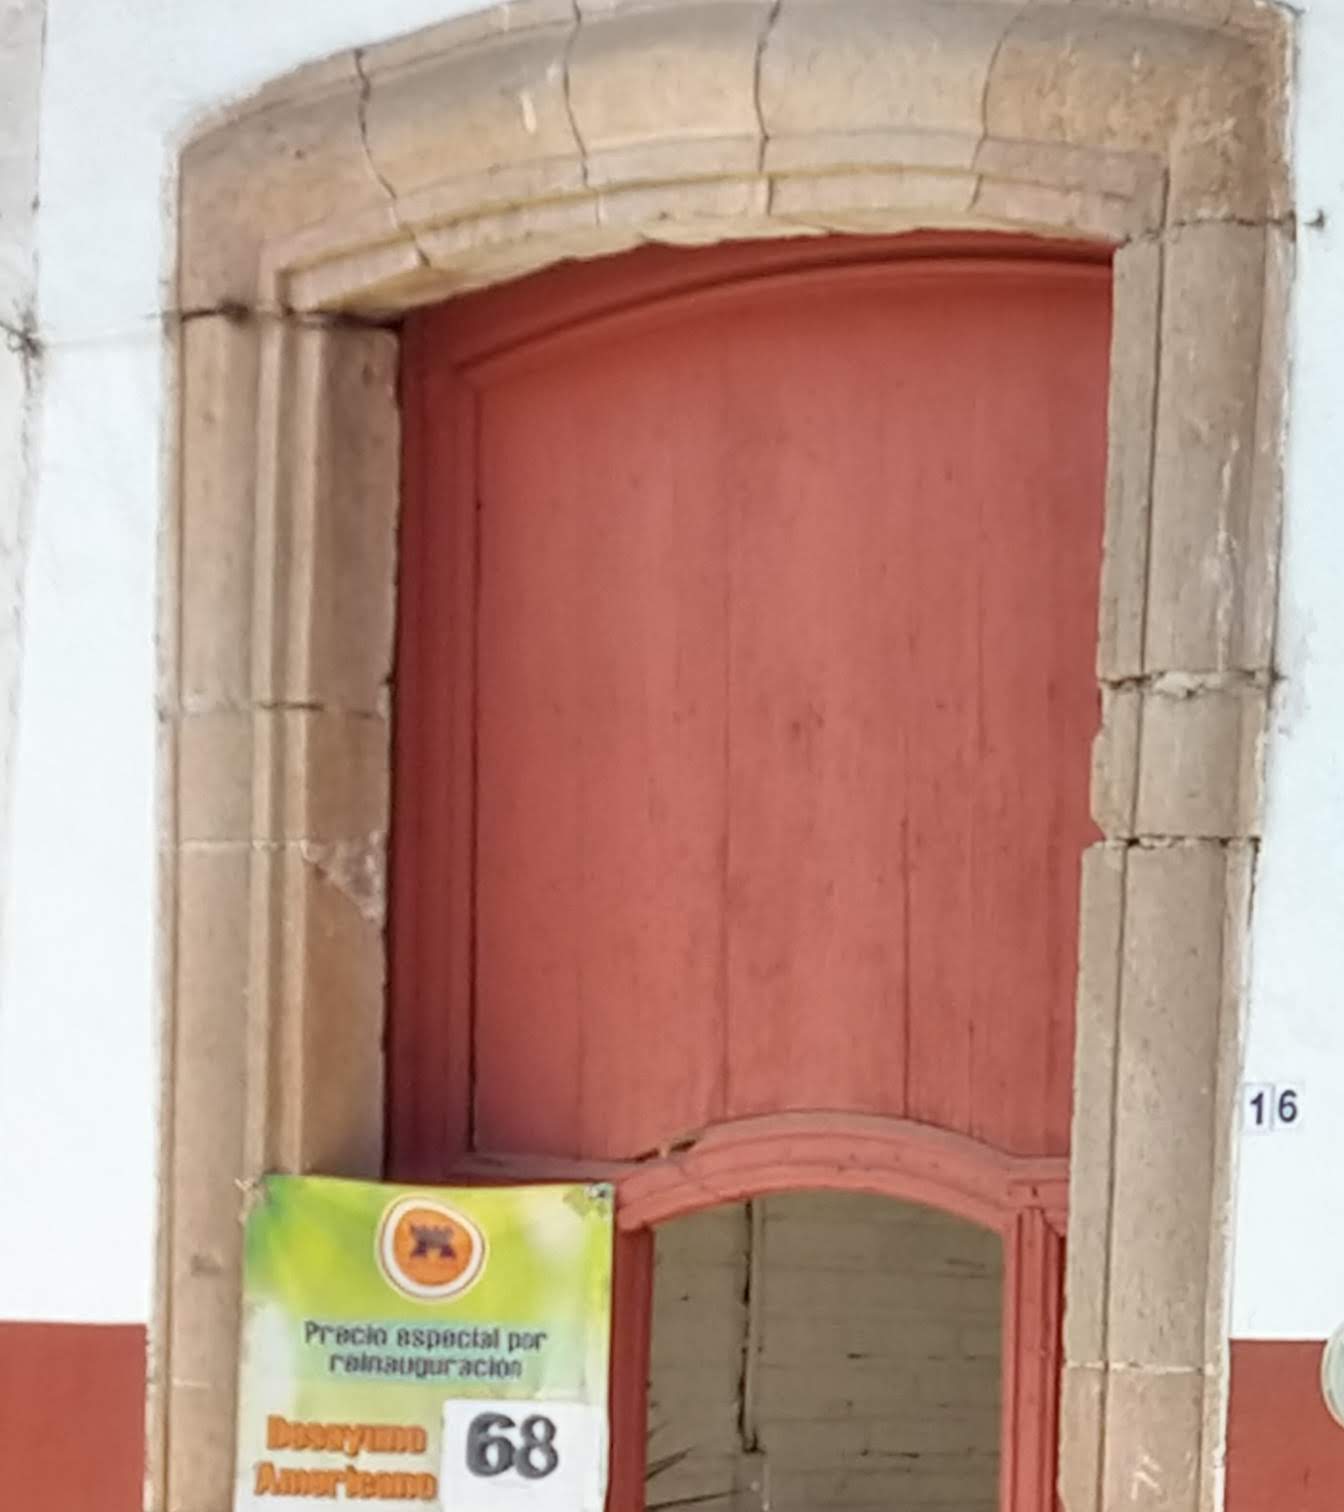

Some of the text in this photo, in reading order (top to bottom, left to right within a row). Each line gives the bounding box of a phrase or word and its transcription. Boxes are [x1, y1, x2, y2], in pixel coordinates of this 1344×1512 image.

[1250, 1089, 1298, 1125] 16
[304, 1320, 548, 1352] Precio especial por
[266, 1414, 427, 1458] Desayuno
[465, 1412, 559, 1480] 68
